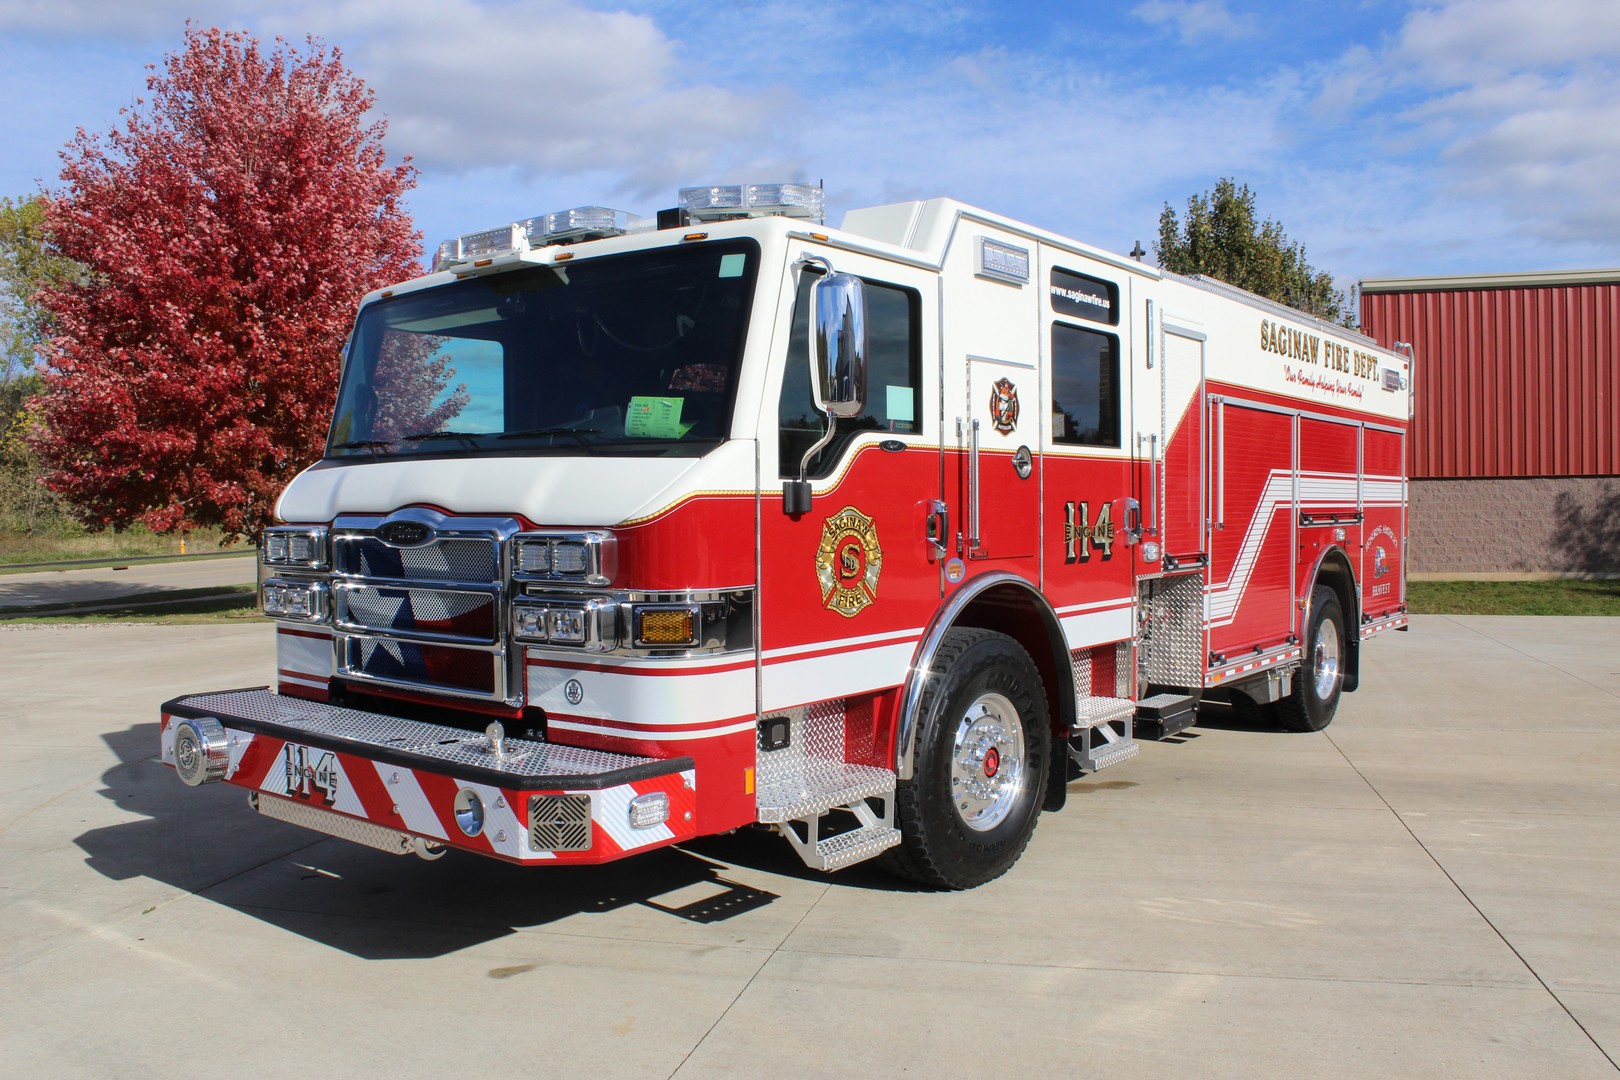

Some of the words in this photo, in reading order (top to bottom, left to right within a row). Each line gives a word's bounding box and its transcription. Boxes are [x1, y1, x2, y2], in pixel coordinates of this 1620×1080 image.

[1050, 285, 1110, 309] www.saginawfire.us
[1260, 319, 1320, 365] SAGINAW
[1324, 340, 1349, 373] FIRE
[1353, 350, 1379, 382] DEPT.
[828, 516, 870, 539] SAGINAW
[1063, 521, 1114, 544] ENGINE
[1064, 501, 1112, 564] 114
[838, 592, 863, 608] FIRE
[284, 743, 336, 806] 114
[285, 760, 337, 791] ENGINE
